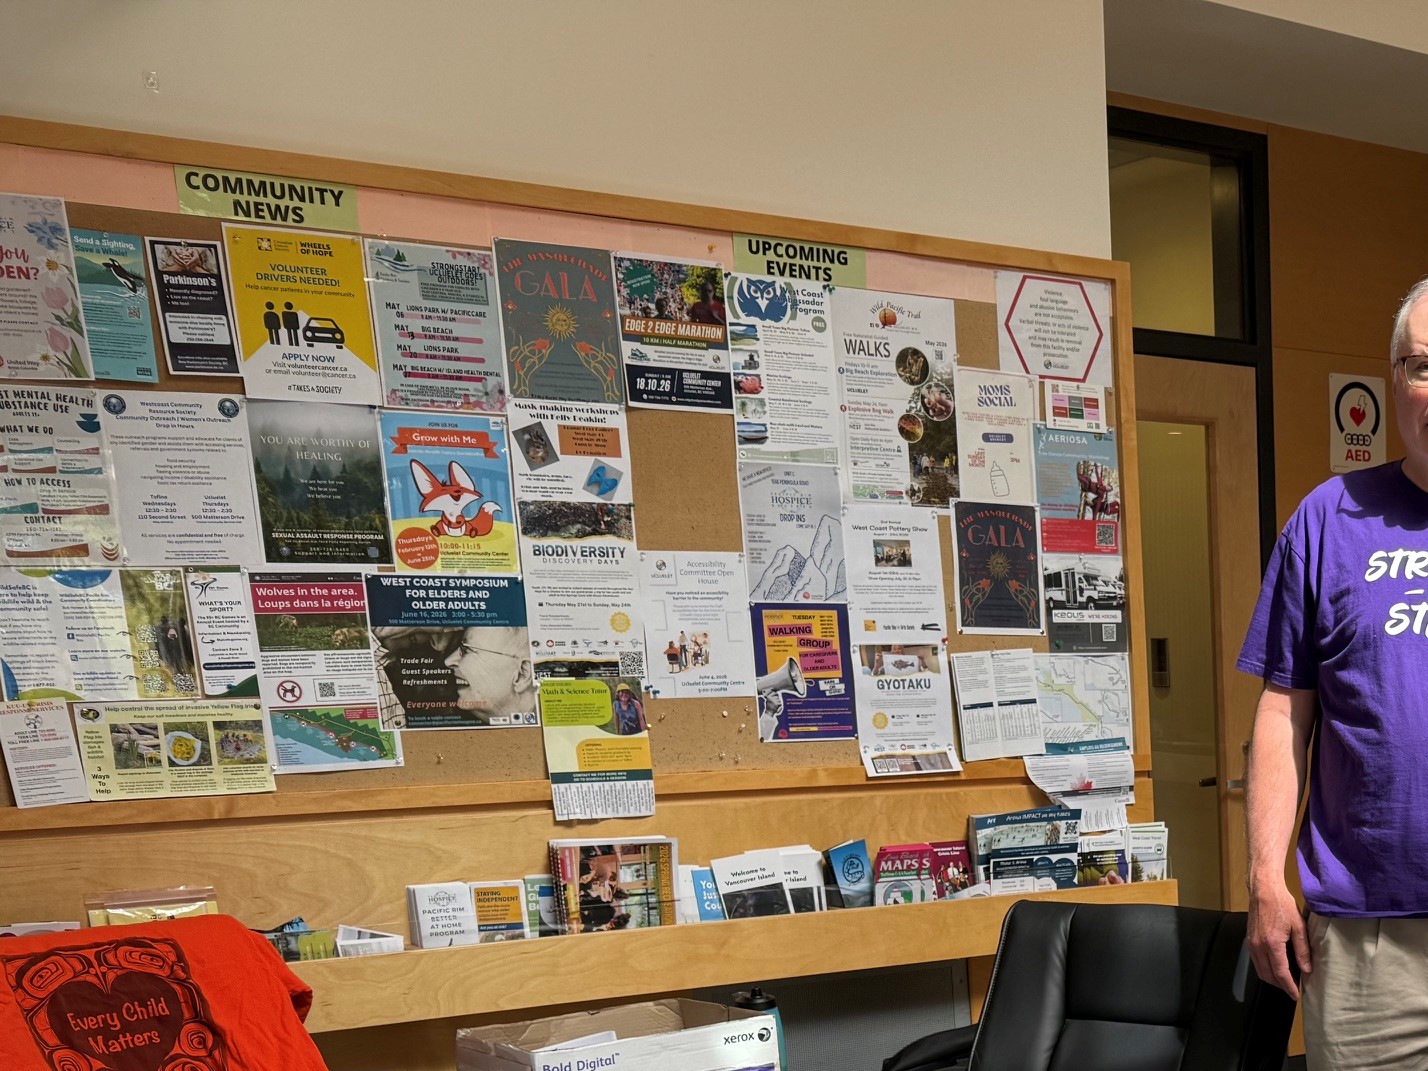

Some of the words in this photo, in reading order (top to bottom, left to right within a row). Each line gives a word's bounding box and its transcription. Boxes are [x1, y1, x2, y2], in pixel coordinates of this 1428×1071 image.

[184, 171, 344, 207] COMMUNITY
[233, 199, 305, 224] NEWS
[299, 241, 331, 251] WHEELS
[748, 239, 848, 266] UPCOMING
[269, 263, 327, 276] VOLUNTEER
[766, 260, 832, 282] EVENTS
[163, 274, 217, 287] Parkinson's
[256, 273, 297, 284] DRIVERS
[299, 276, 340, 287] NEEDED!
[514, 270, 598, 302] GALA
[625, 318, 646, 332] EDGE
[648, 321, 652, 332] 2
[655, 322, 676, 334] EDGE
[678, 324, 723, 340] MARATHON
[844, 338, 891, 358] WALKS
[282, 352, 309, 362] APPLY
[312, 354, 335, 363] NOW
[636, 377, 670, 392] 18.10.26
[978, 385, 1011, 396] MOMS
[978, 396, 1016, 407] SOCIAL
[260, 435, 283, 444] YOU
[287, 436, 308, 446] ARE
[310, 438, 356, 448] WORTHY
[358, 440, 372, 448] OF
[412, 433, 438, 442] Grow
[440, 434, 460, 443] with
[462, 436, 476, 444] Me
[1048, 434, 1088, 445] AERIOSA
[296, 451, 342, 461] HEALING
[1346, 449, 1371, 462] AED
[24, 516, 62, 525] CONTACT
[968, 524, 1026, 548] GALA
[532, 544, 626, 558] BIODIVERSITY
[380, 577, 412, 586] WEST
[413, 578, 448, 587] COAST
[448, 579, 508, 588] SYMPOSIUM
[256, 587, 295, 596] Wolves
[298, 587, 309, 596] in
[312, 586, 328, 596] the
[331, 588, 358, 596] area.
[406, 590, 428, 598] FOR
[428, 590, 466, 598] ELDERS
[468, 590, 490, 598] AND
[258, 600, 290, 610] Loups
[293, 599, 318, 608] dans
[322, 598, 330, 607] la
[412, 601, 446, 610] OLDER
[448, 601, 486, 610] ADULTS
[769, 626, 812, 636] WALKING
[799, 638, 830, 649] GROUP
[422, 668, 452, 676] Speakers
[876, 679, 931, 690] GYOTAKU
[880, 859, 919, 871] MAPS
[724, 876, 756, 886] Vancouver
[758, 872, 776, 880] Island
[730, 869, 758, 878] Welcome
[66, 1011, 120, 1034] Every
[122, 998, 170, 1022] Child
[88, 1029, 160, 1056] Matters
[723, 1031, 755, 1046] xerox
